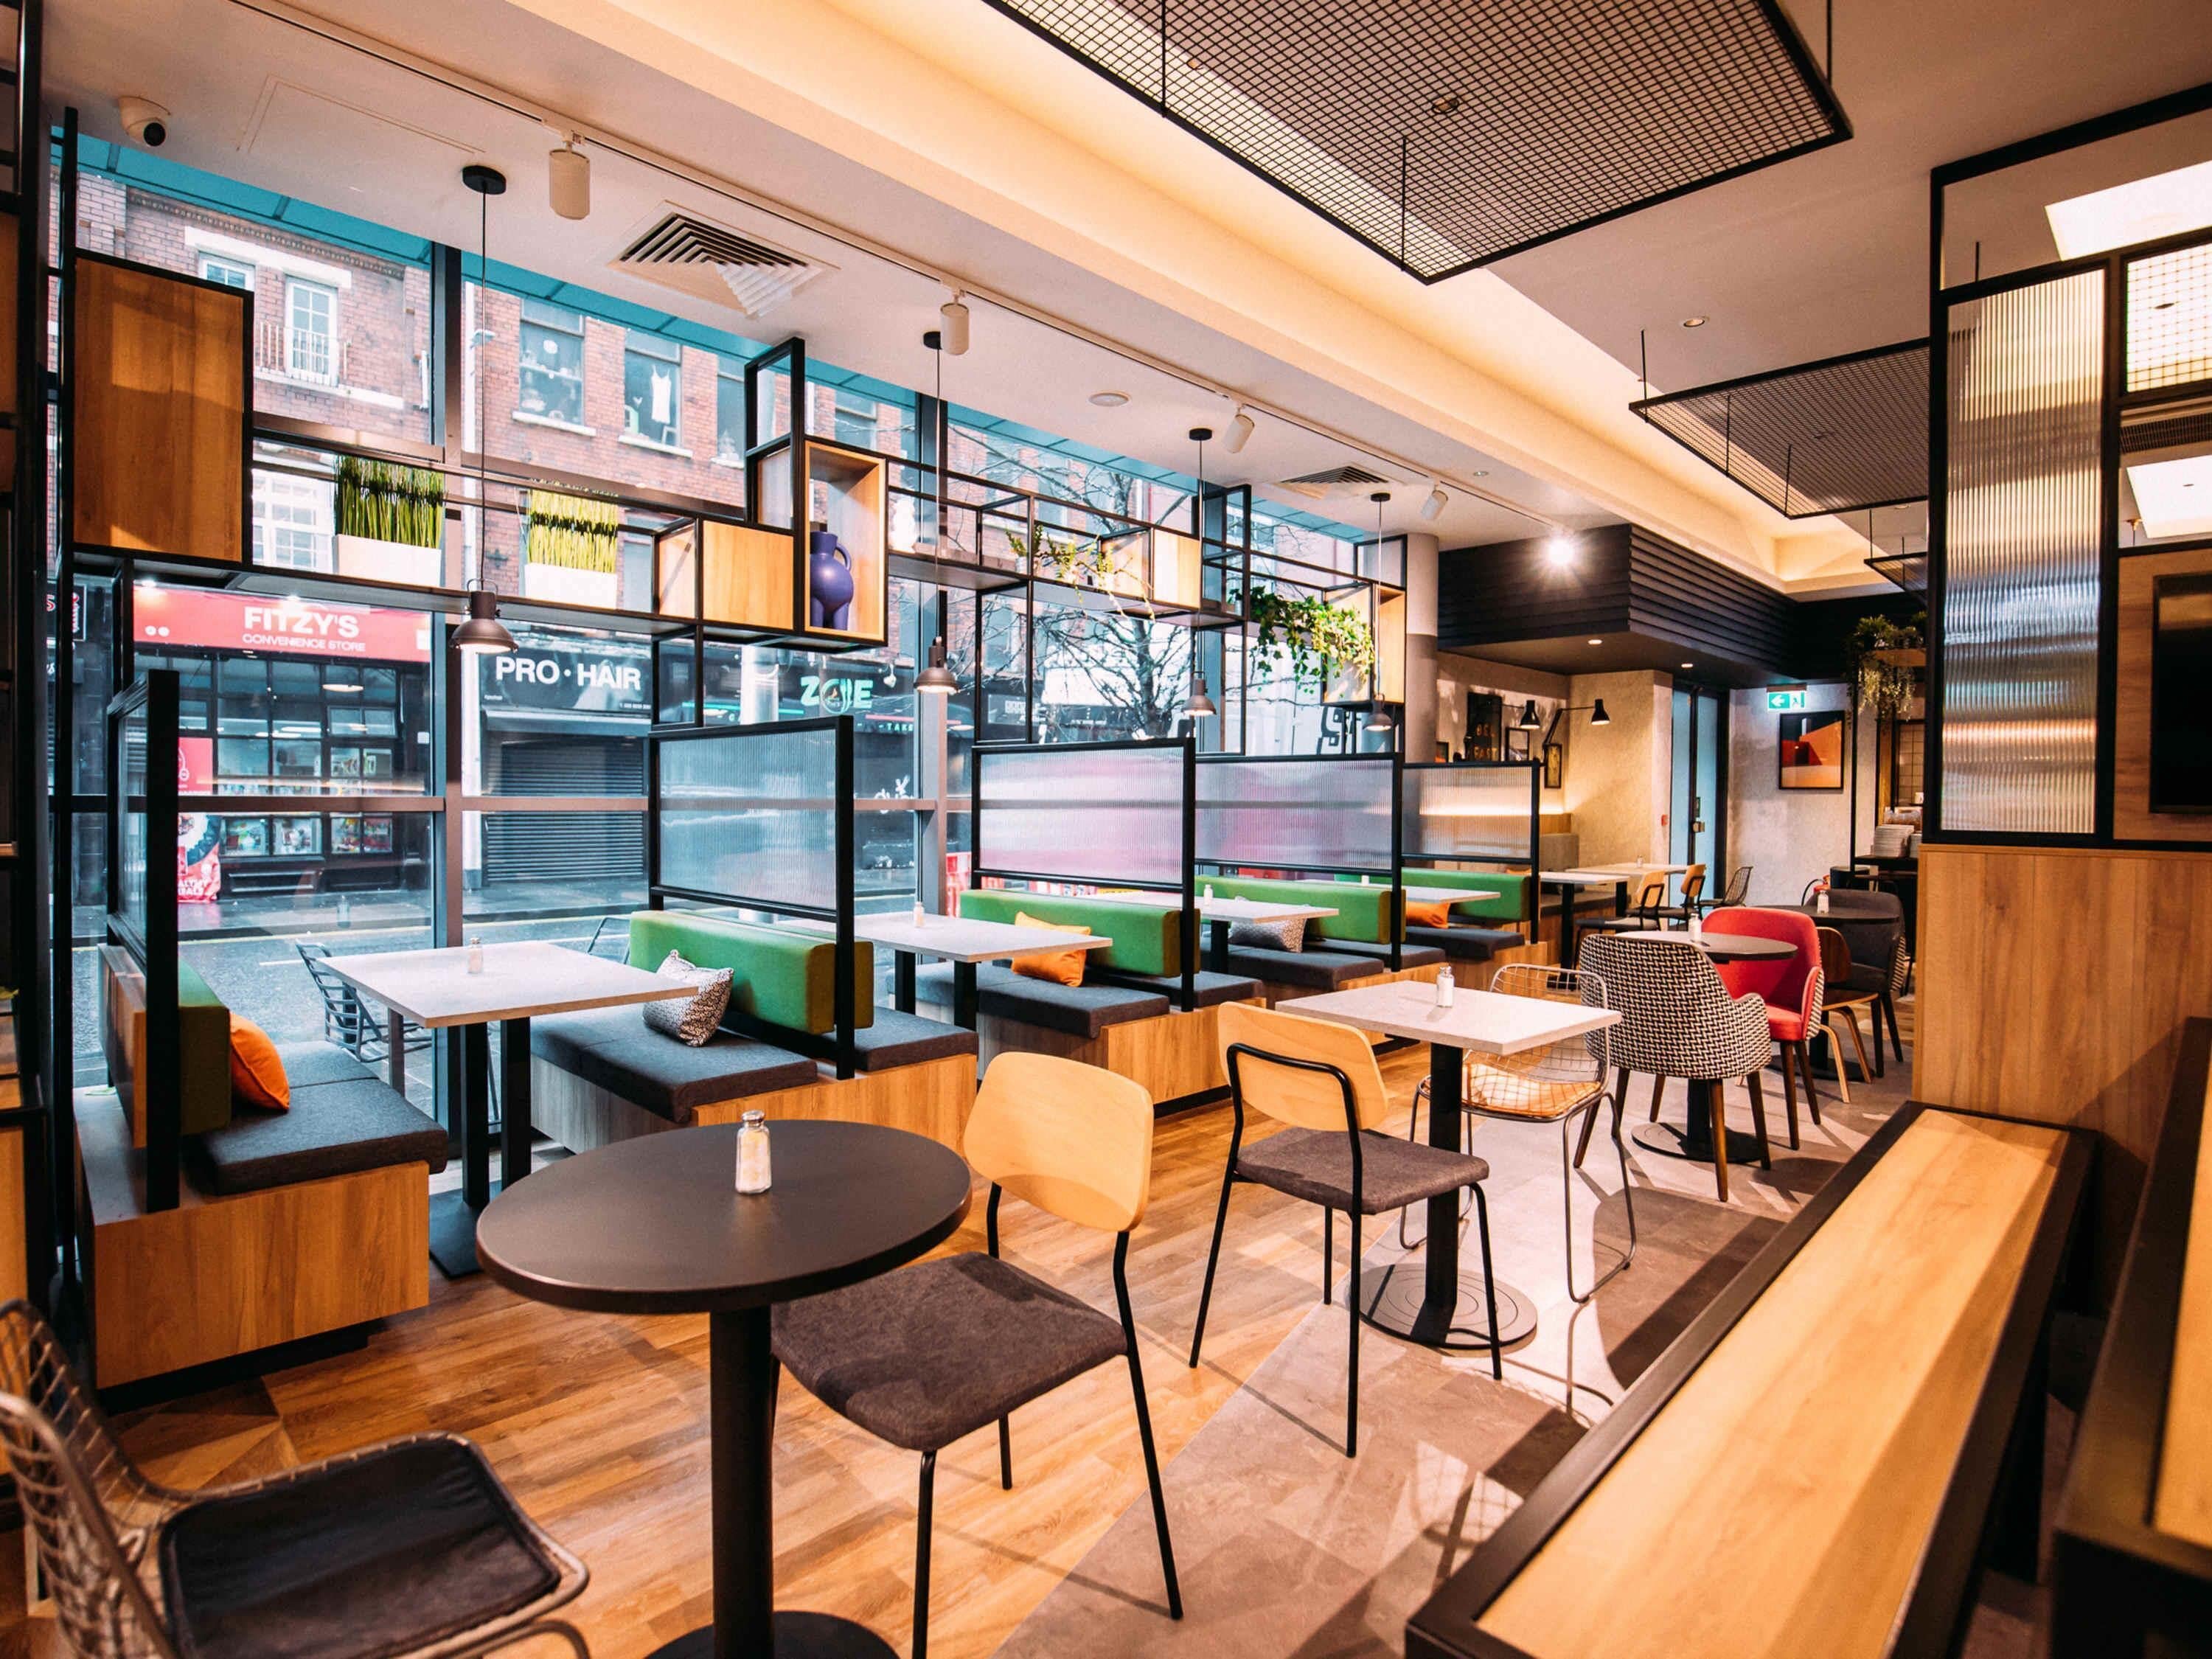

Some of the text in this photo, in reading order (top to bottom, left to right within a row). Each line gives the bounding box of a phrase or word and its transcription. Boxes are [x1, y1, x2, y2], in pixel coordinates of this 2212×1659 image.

[244, 606, 359, 639] FITZY'S
[242, 633, 366, 652] CONVENIENCE STORE
[495, 656, 641, 691] PRO HAIR
